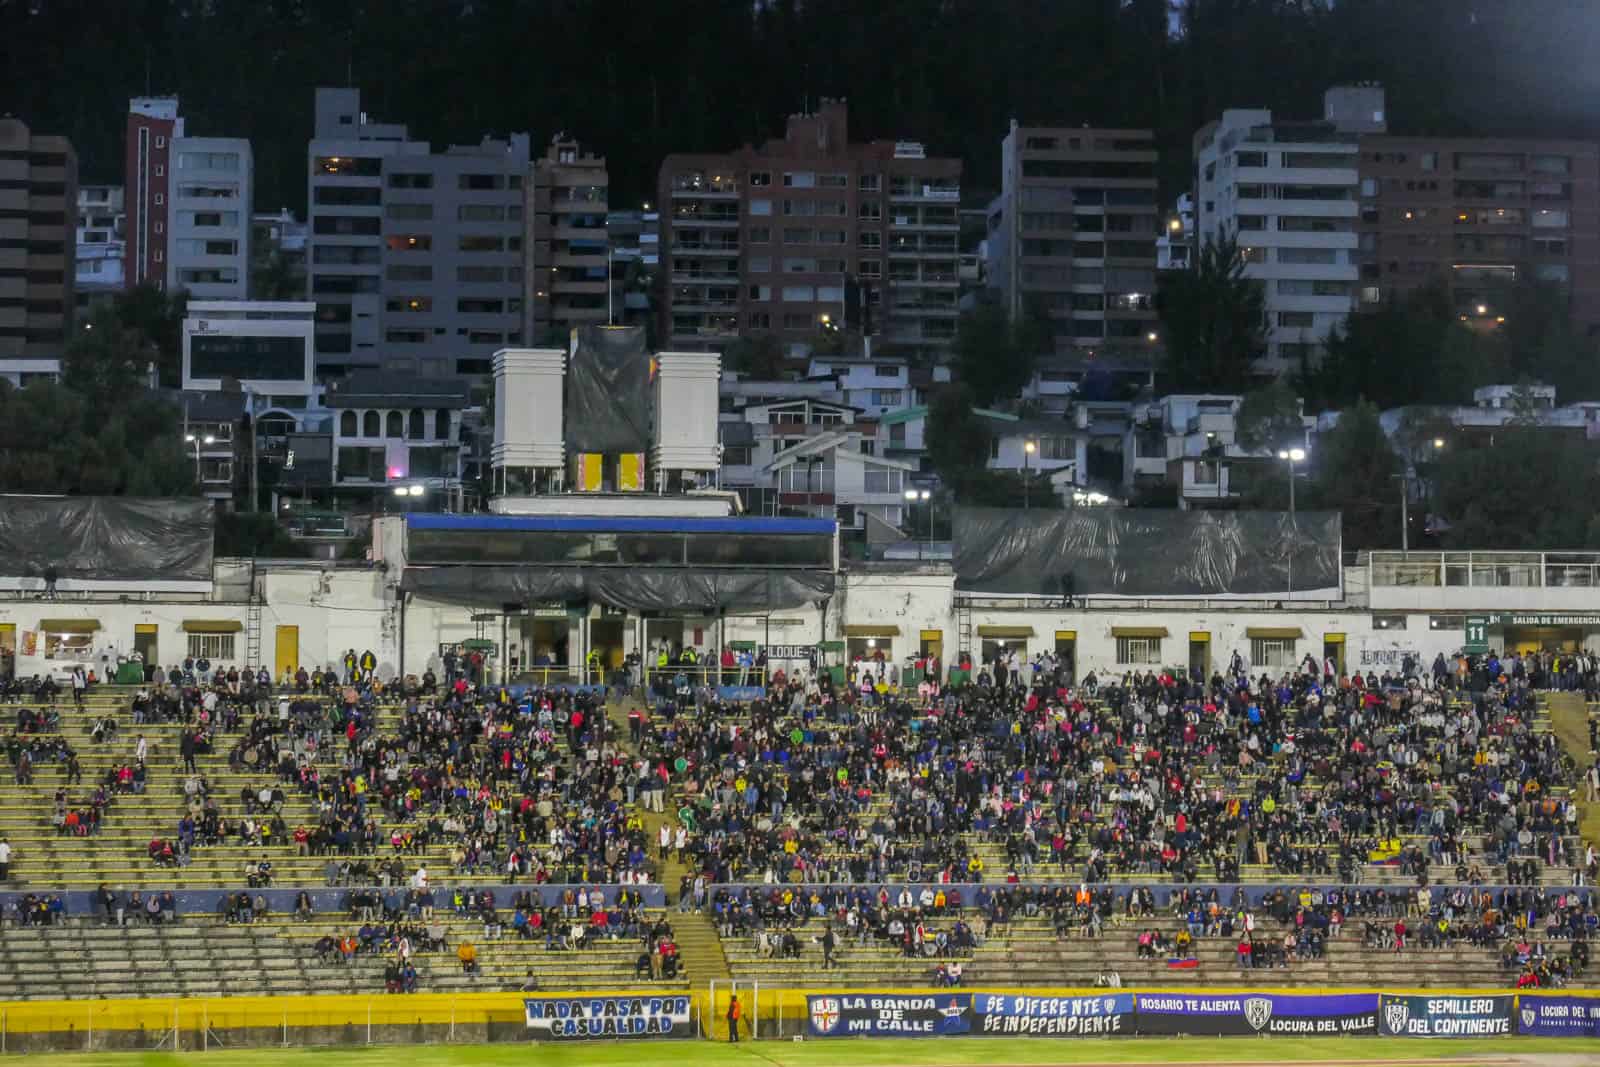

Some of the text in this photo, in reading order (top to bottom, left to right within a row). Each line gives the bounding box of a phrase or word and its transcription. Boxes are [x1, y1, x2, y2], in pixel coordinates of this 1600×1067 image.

[1468, 626, 1484, 641] 11
[527, 997, 688, 1019] NADA PASA POR
[842, 998, 936, 1010] LA BANDA
[1140, 998, 1241, 1011] ROSARIO TE ALIENTA
[1428, 1000, 1494, 1014] SEMILLERO
[879, 1009, 905, 1020] DE
[1541, 1005, 1569, 1017] LOCURA
[1572, 1006, 1585, 1018] DEL
[551, 1015, 673, 1037] CASUALIDAD
[848, 1020, 934, 1032] MI CALLE
[1270, 1016, 1375, 1032] LOCURA DEL VALLE
[1408, 1017, 1509, 1033] DEL CONTINENTE
